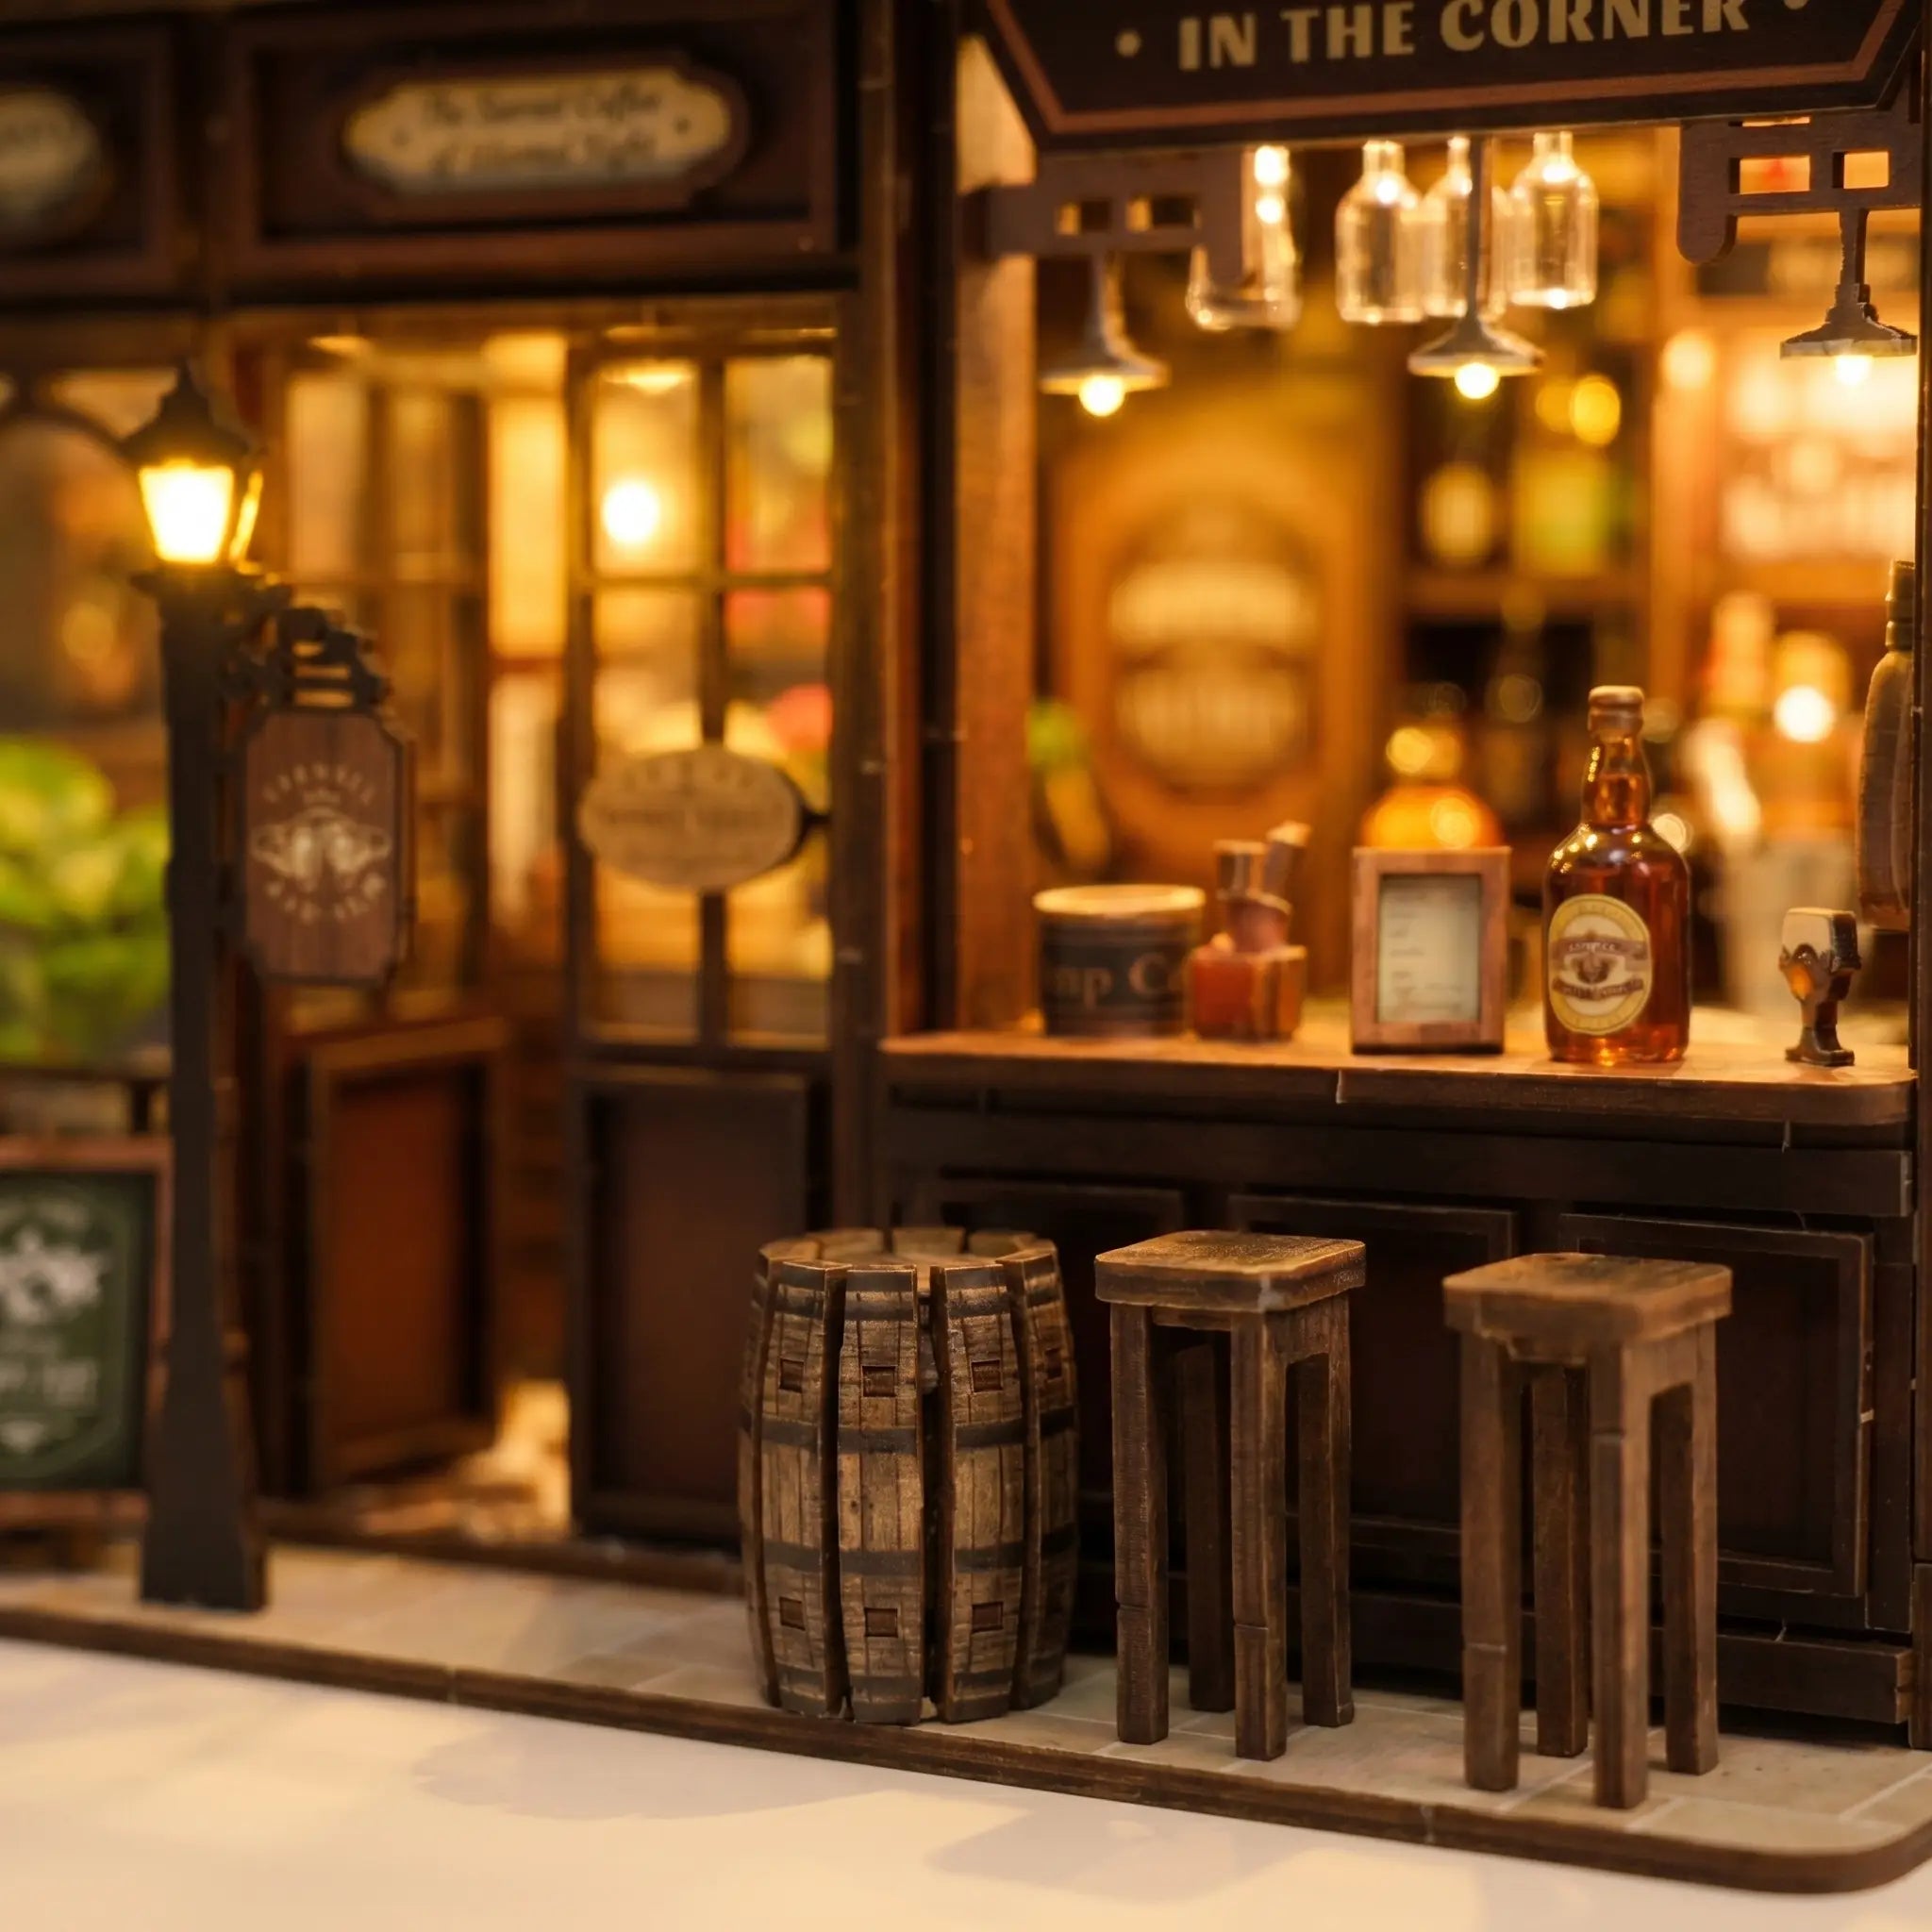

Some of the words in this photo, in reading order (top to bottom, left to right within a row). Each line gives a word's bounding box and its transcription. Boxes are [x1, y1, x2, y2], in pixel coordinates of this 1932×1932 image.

[1179, 12, 1257, 71] IN
[1279, 2, 1414, 62] THE
[1440, 0, 1750, 51] CORNER
